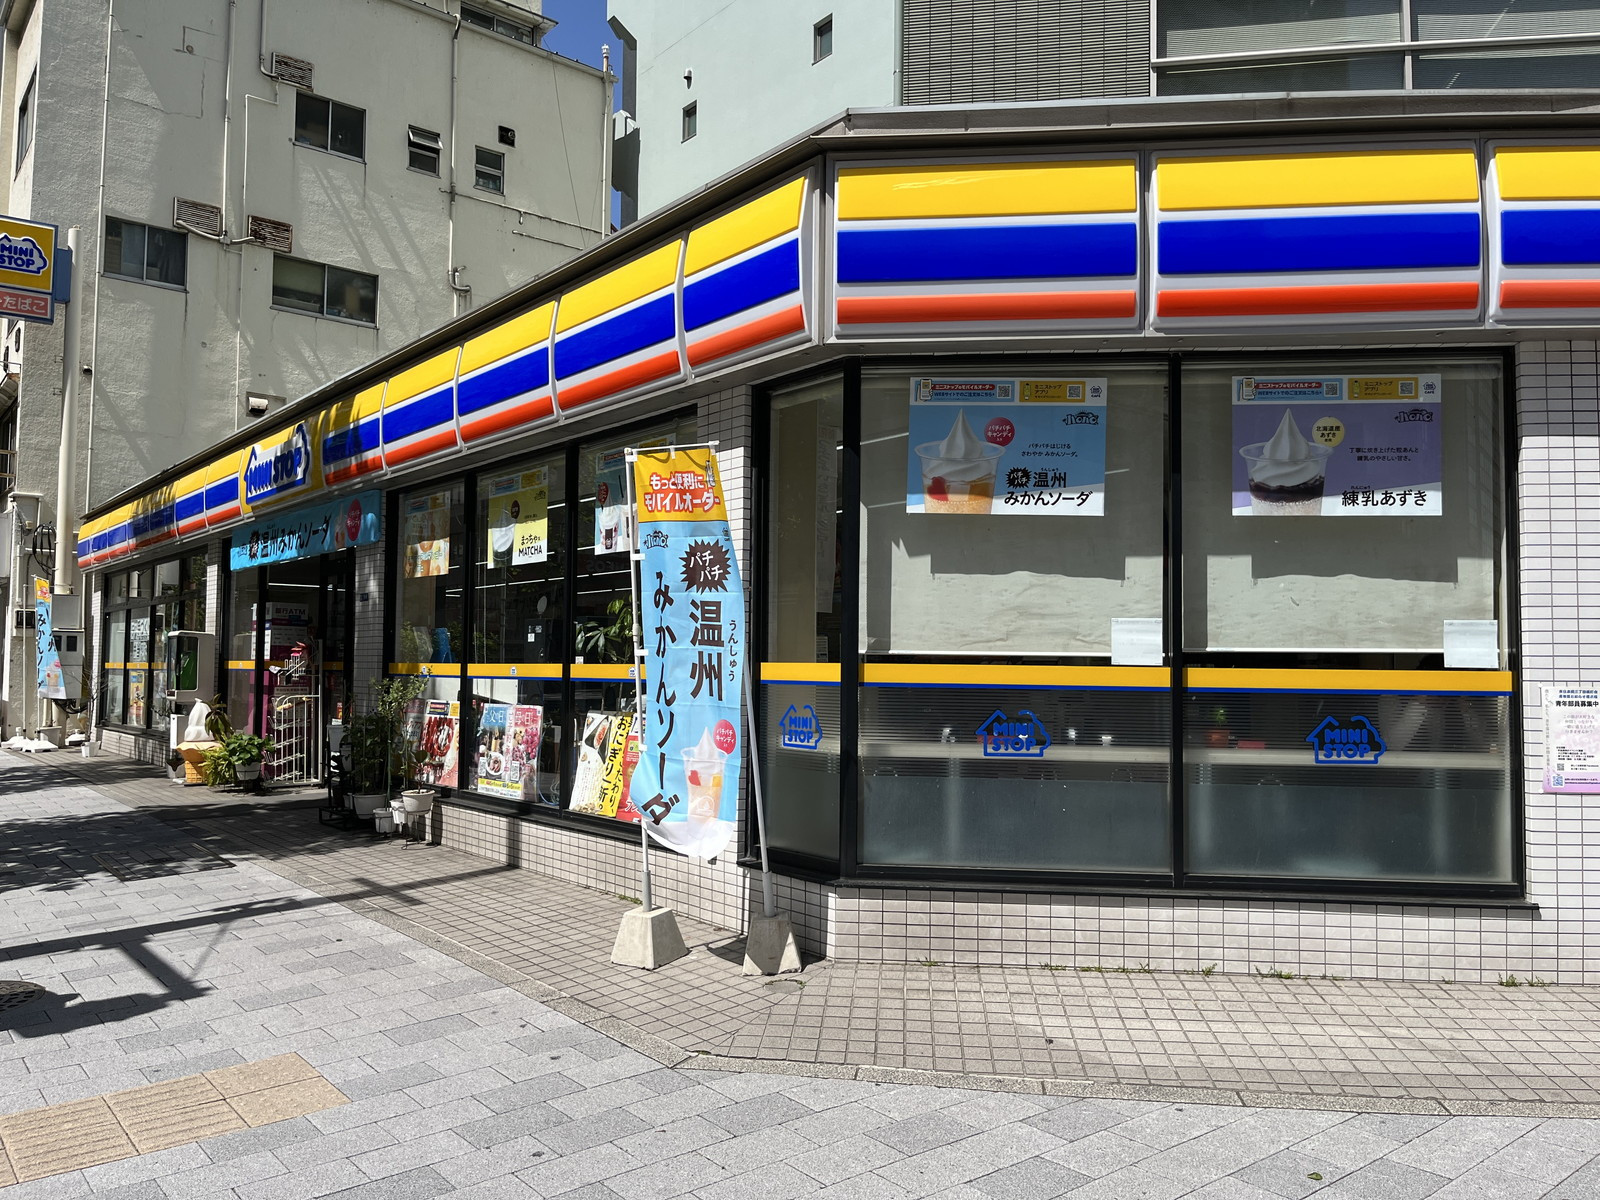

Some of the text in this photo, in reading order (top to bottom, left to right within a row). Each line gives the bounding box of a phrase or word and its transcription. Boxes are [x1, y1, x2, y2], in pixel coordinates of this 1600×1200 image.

[0, 243, 34, 258] MINI
[0, 255, 36, 269] STOP
[247, 446, 303, 496] MINI STOP
[1010, 471, 1024, 479] パチ
[650, 472, 706, 490] もっと便利に
[1014, 477, 1028, 485] パチ
[1033, 472, 1067, 488] 温州
[644, 490, 721, 512] モバイルオーダー
[1004, 491, 1094, 507] みかんソーダ
[1341, 489, 1427, 507] 練乳あずき
[518, 544, 543, 558] MATCHA
[689, 550, 714, 567] パチ
[699, 565, 724, 582] パチ
[689, 598, 724, 702] 温州
[728, 620, 738, 682] うんしゅう
[641, 571, 680, 827] みかんソーダ
[788, 715, 812, 729] MINI
[992, 721, 1035, 737] MINI
[715, 735, 735, 743] キャンディ
[716, 728, 734, 736] パチパチ
[787, 729, 814, 744] STOP
[1323, 728, 1369, 743] MINI
[991, 736, 1037, 752] STOP
[1323, 743, 1371, 759] STOP
